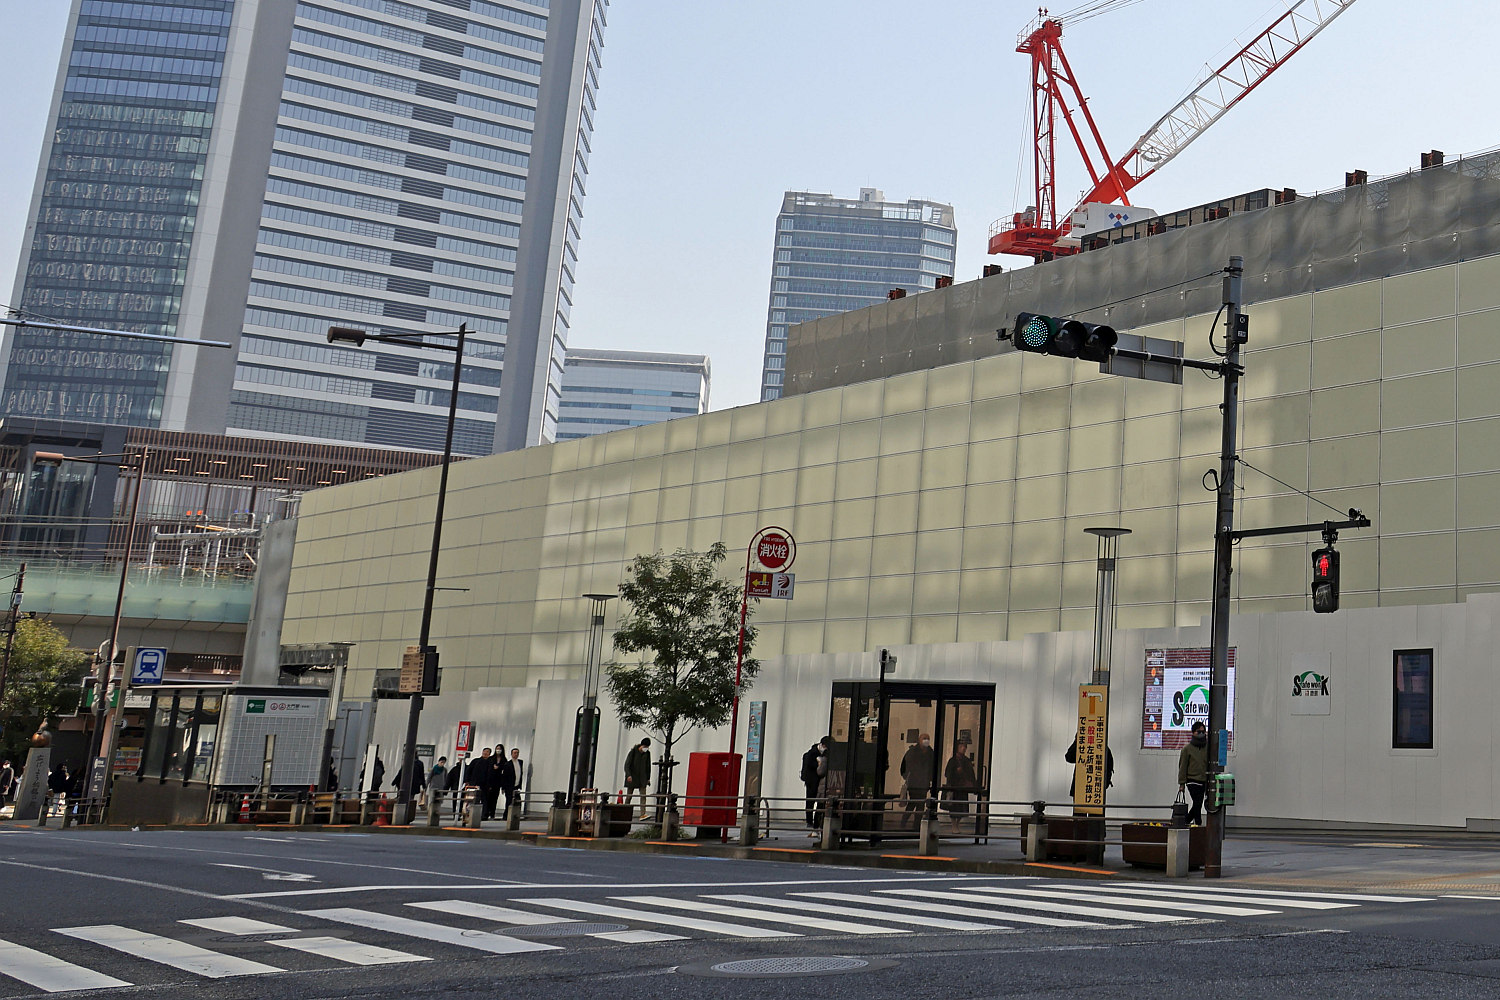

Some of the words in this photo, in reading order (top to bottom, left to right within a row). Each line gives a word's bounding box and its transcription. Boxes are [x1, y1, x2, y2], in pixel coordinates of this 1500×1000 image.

[760, 543, 787, 559] 消火栓
[1078, 716, 1087, 764] できません
[1085, 719, 1096, 803] 一般車左折通り抜け
